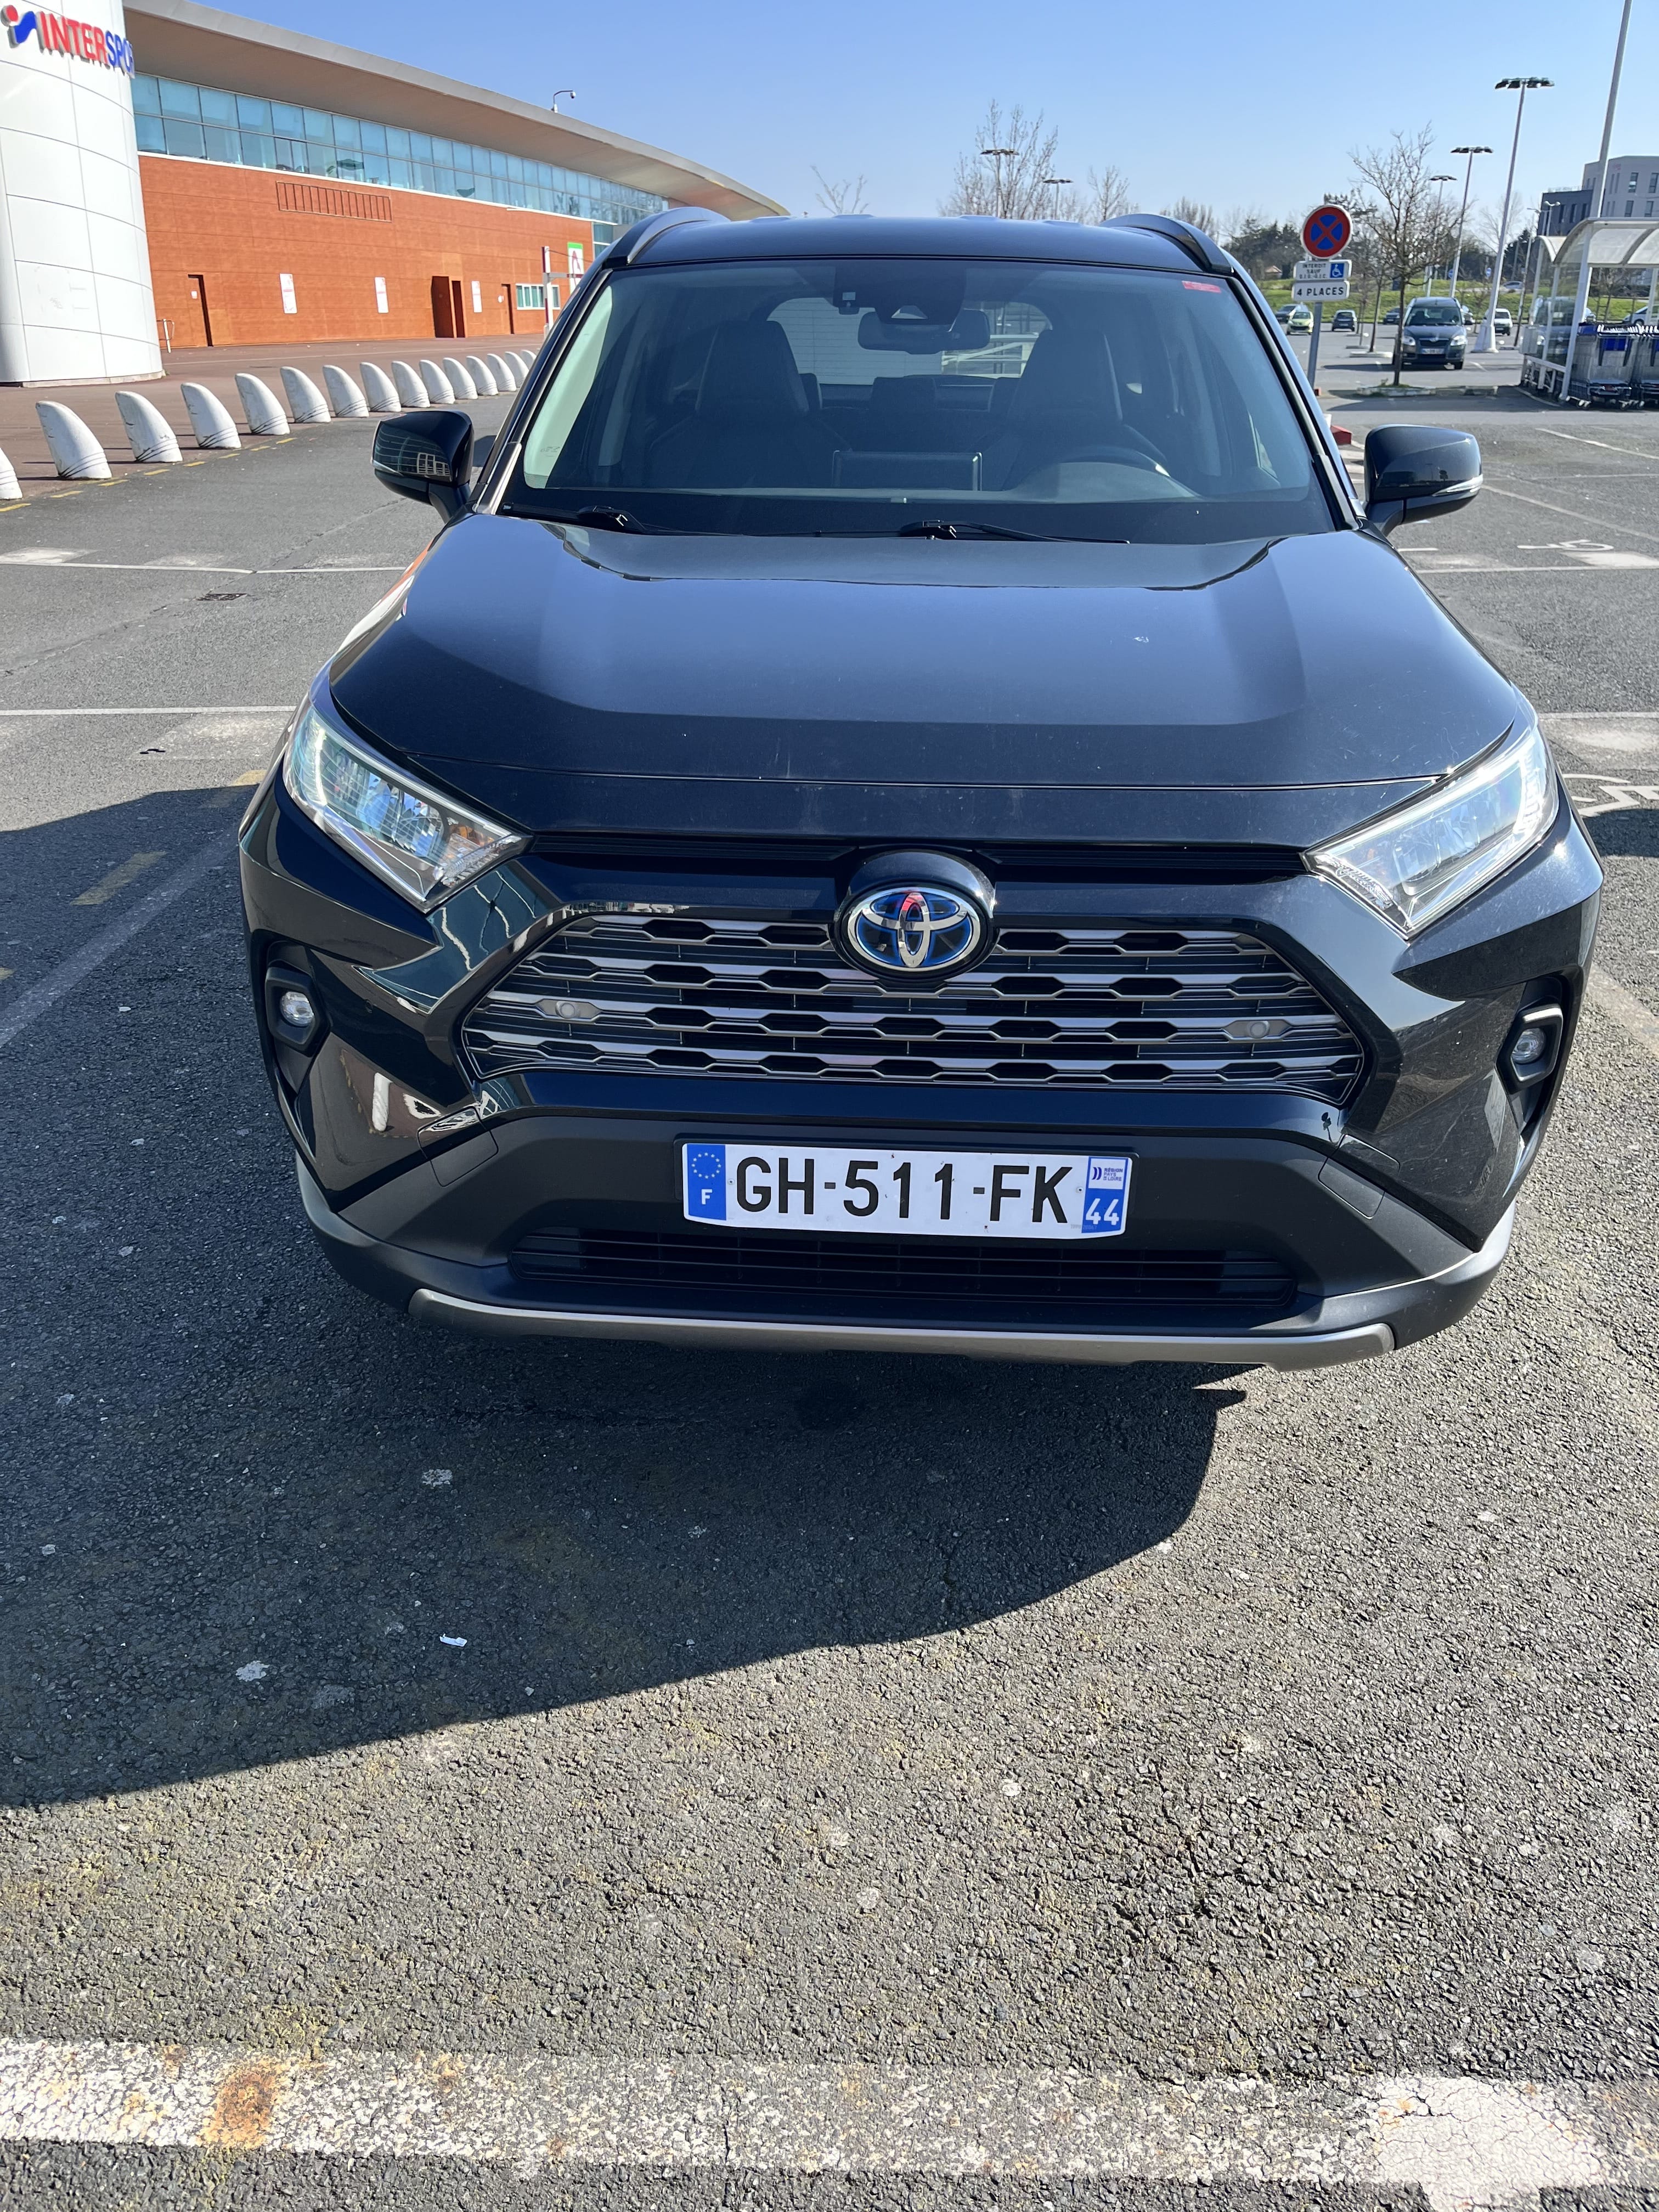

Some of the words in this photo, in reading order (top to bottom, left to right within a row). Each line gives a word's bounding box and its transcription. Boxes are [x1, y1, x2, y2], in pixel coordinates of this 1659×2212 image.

[1306, 287, 1344, 296] PLACES
[701, 1188, 713, 1205] F
[737, 1156, 1073, 1223] GH-511-FK
[1085, 1198, 1120, 1226] 44
